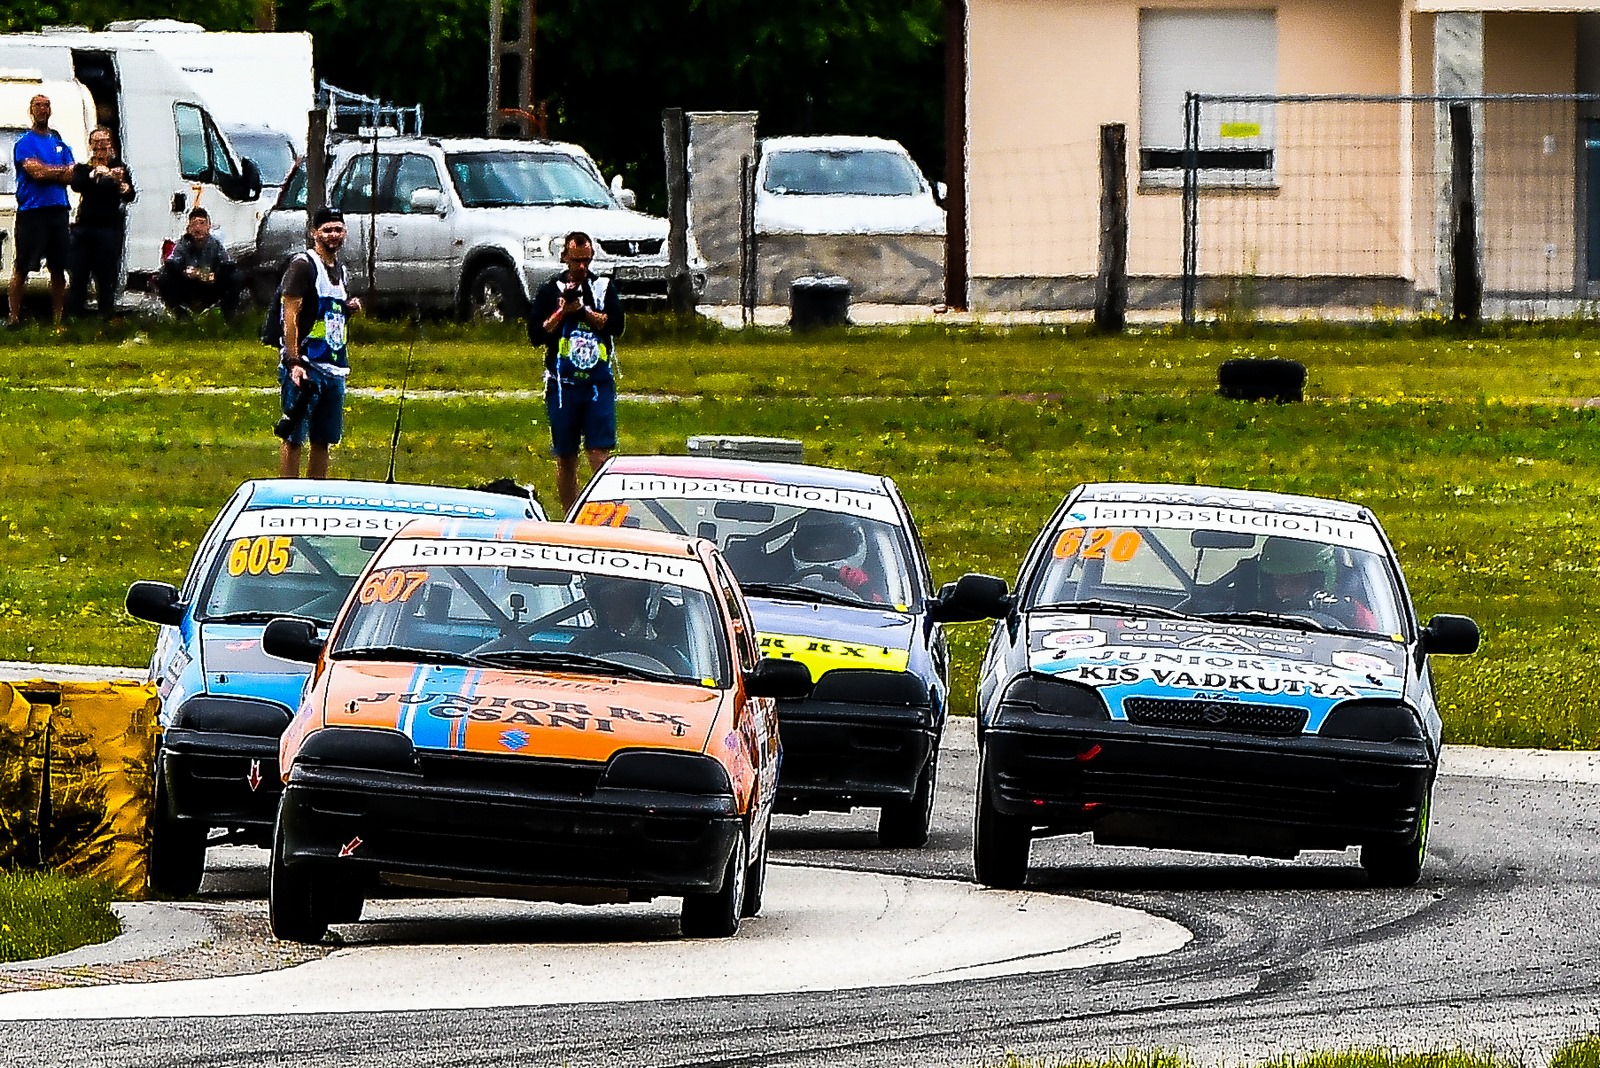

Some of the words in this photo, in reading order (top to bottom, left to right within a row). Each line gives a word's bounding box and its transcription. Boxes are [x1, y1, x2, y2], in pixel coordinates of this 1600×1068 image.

[621, 478, 872, 511] lampastudio.hu
[1093, 506, 1354, 539] lampastudio.hu
[228, 536, 292, 577] 605
[412, 543, 684, 578] lampastudio.hu
[1053, 526, 1143, 562] 620
[359, 569, 430, 605] 607
[1079, 666, 1140, 681] KIS
[1150, 669, 1356, 697] VADKUTYA
[1090, 651, 1265, 671] JUNIOR
[1281, 663, 1340, 679] RX
[357, 692, 593, 716] JUNIOR
[607, 705, 691, 727] RX
[429, 705, 615, 733] CSANI
